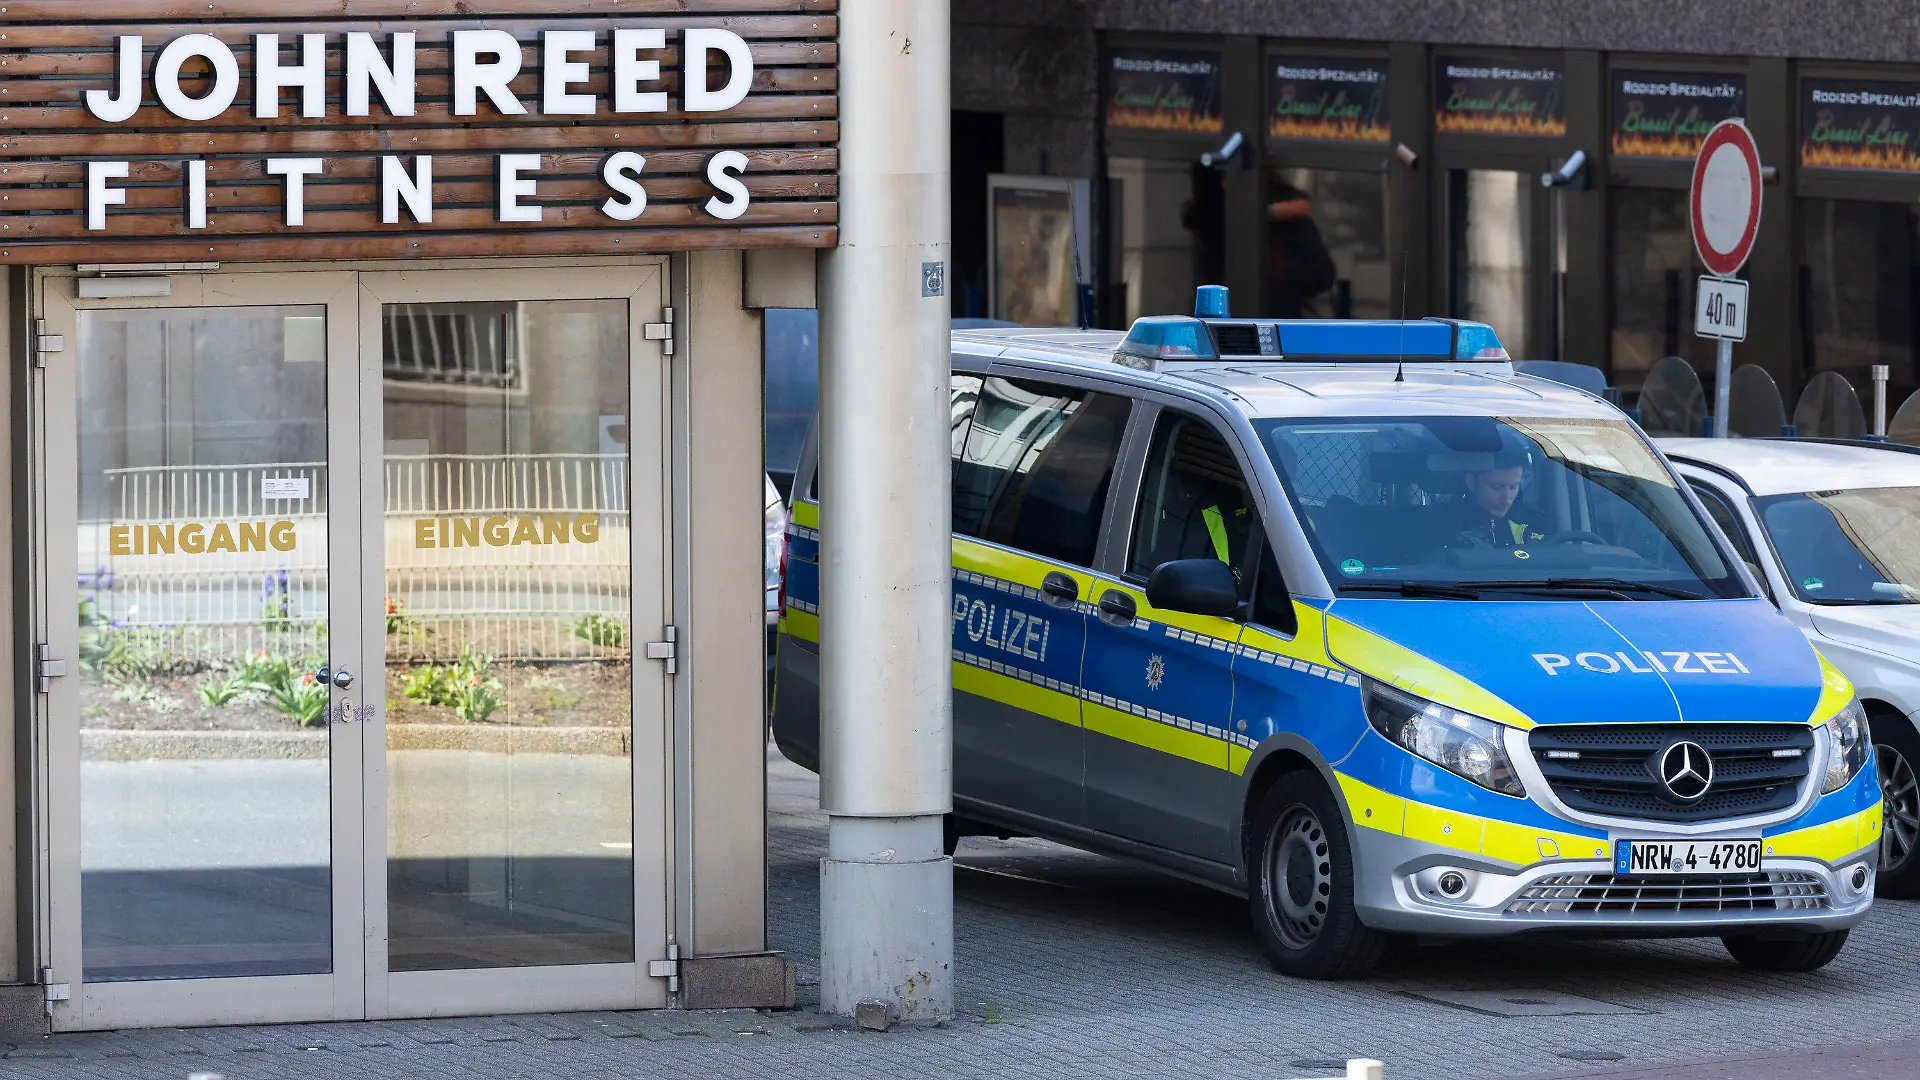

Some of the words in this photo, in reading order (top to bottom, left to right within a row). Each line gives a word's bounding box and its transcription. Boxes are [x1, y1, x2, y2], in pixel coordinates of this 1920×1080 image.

[84, 31, 416, 122] JOHN
[451, 28, 754, 115] REED
[86, 150, 750, 230] FITNESS
[1706, 292, 1723, 325] 40
[1725, 302, 1736, 327] m
[110, 520, 296, 556] EINGANG
[415, 513, 600, 549] EINGANG
[952, 593, 1050, 662] POLIZEI
[1531, 651, 1751, 676] POLIZEI
[1620, 860, 1627, 868] D
[1631, 844, 1673, 870] NRW
[1685, 843, 1760, 870] 4-4780
